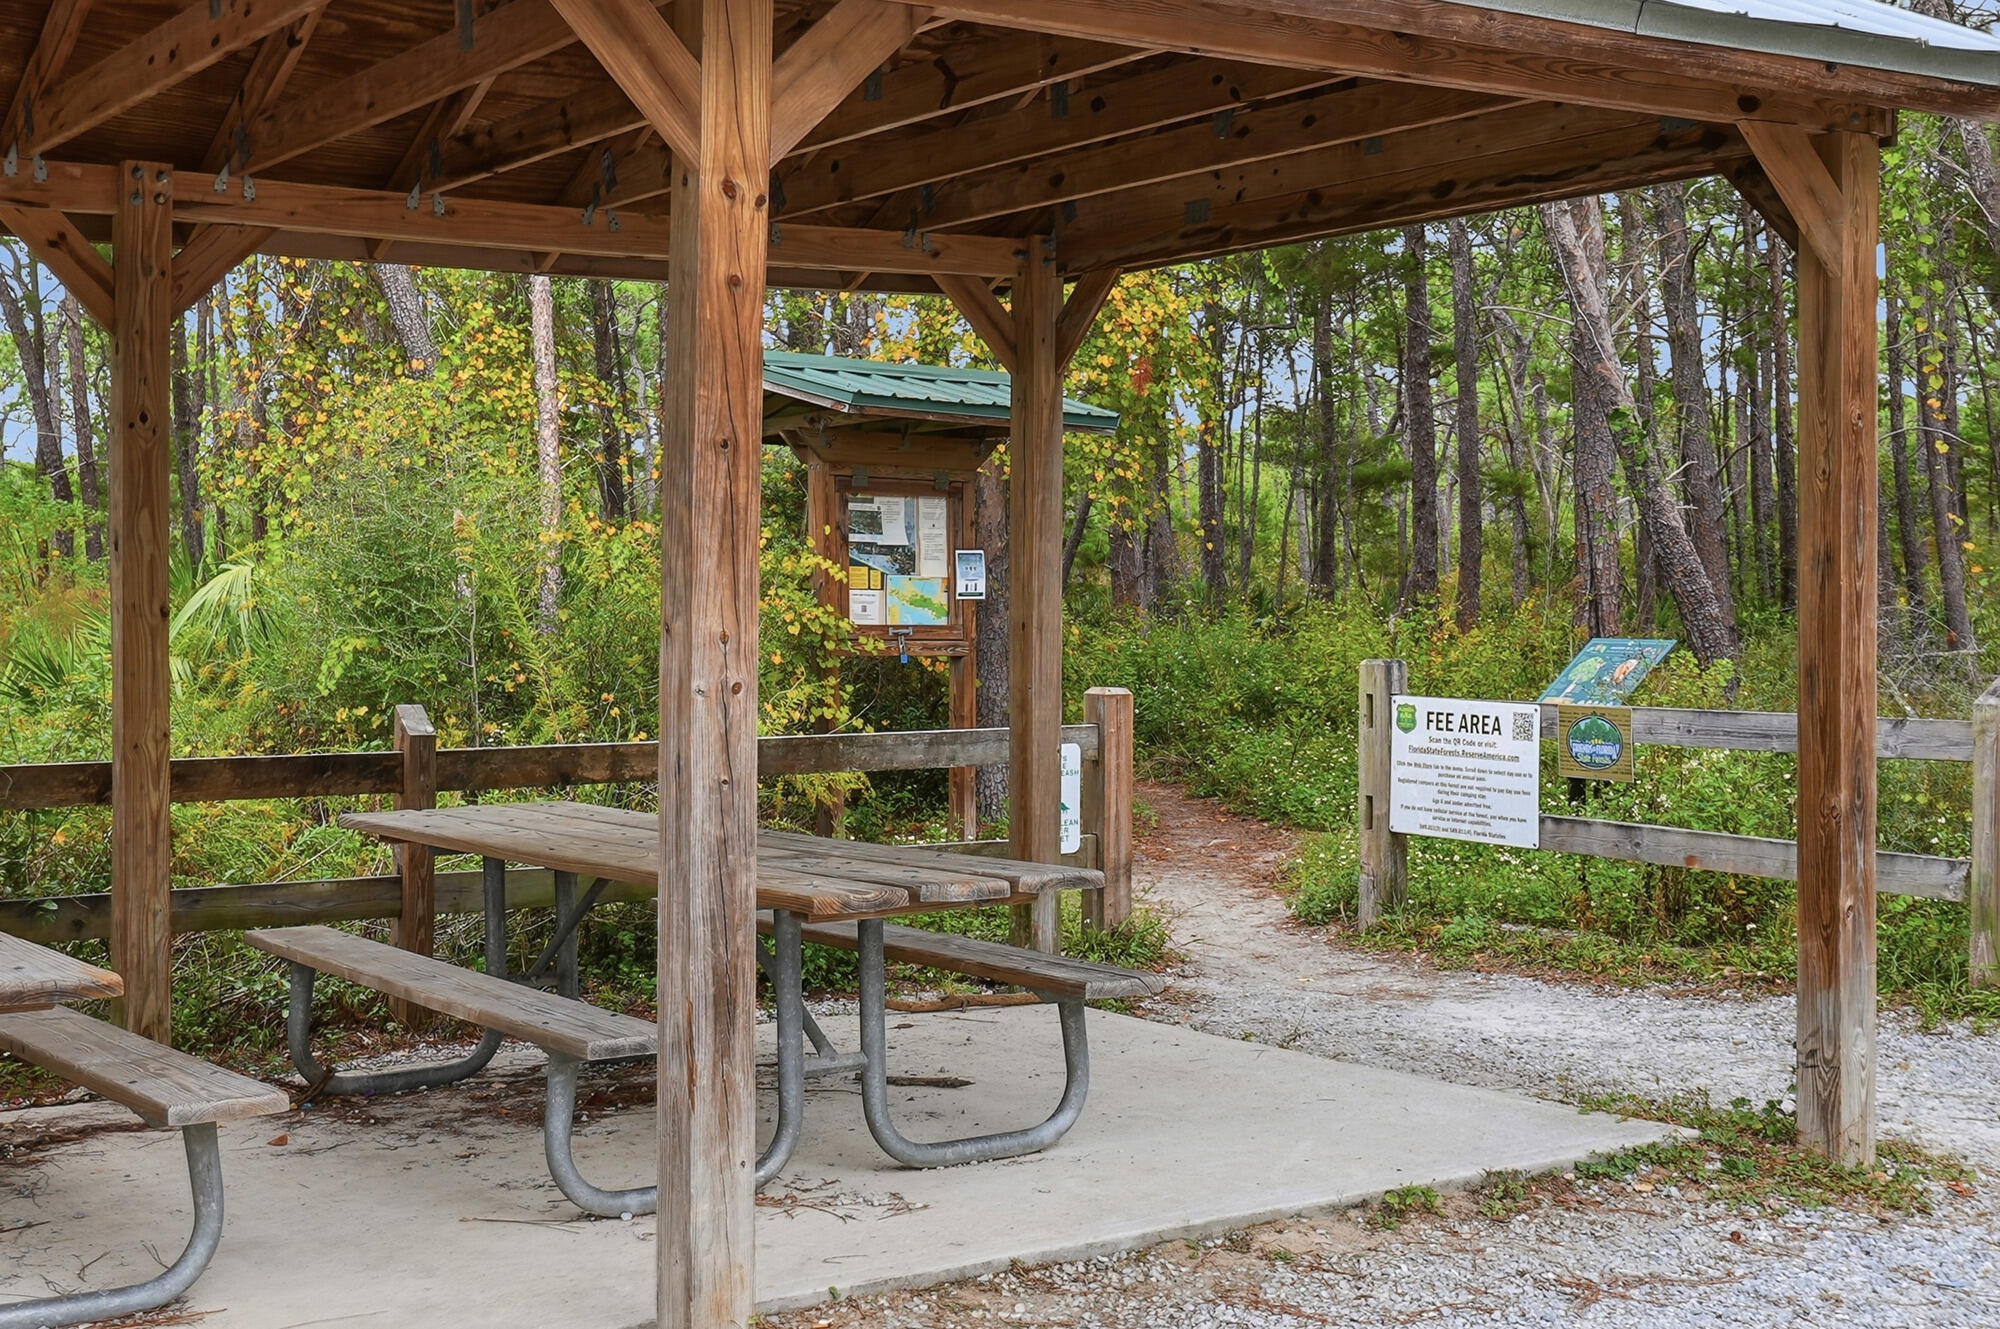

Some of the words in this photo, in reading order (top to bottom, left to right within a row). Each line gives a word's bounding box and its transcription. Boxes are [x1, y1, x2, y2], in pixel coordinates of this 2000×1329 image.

[1426, 711, 1455, 732] FEE
[1458, 713, 1502, 736] AREA
[1428, 736, 1442, 744] Scan
[1443, 737, 1452, 745] the
[1453, 737, 1461, 746] QR
[1462, 738, 1476, 747] Code
[1408, 745, 1520, 762] FloridaStateForests.ReserveAmerica.com
[1061, 768, 1079, 777] EASH
[1460, 791, 1477, 799] camping
[1488, 831, 1506, 839] Statutes
